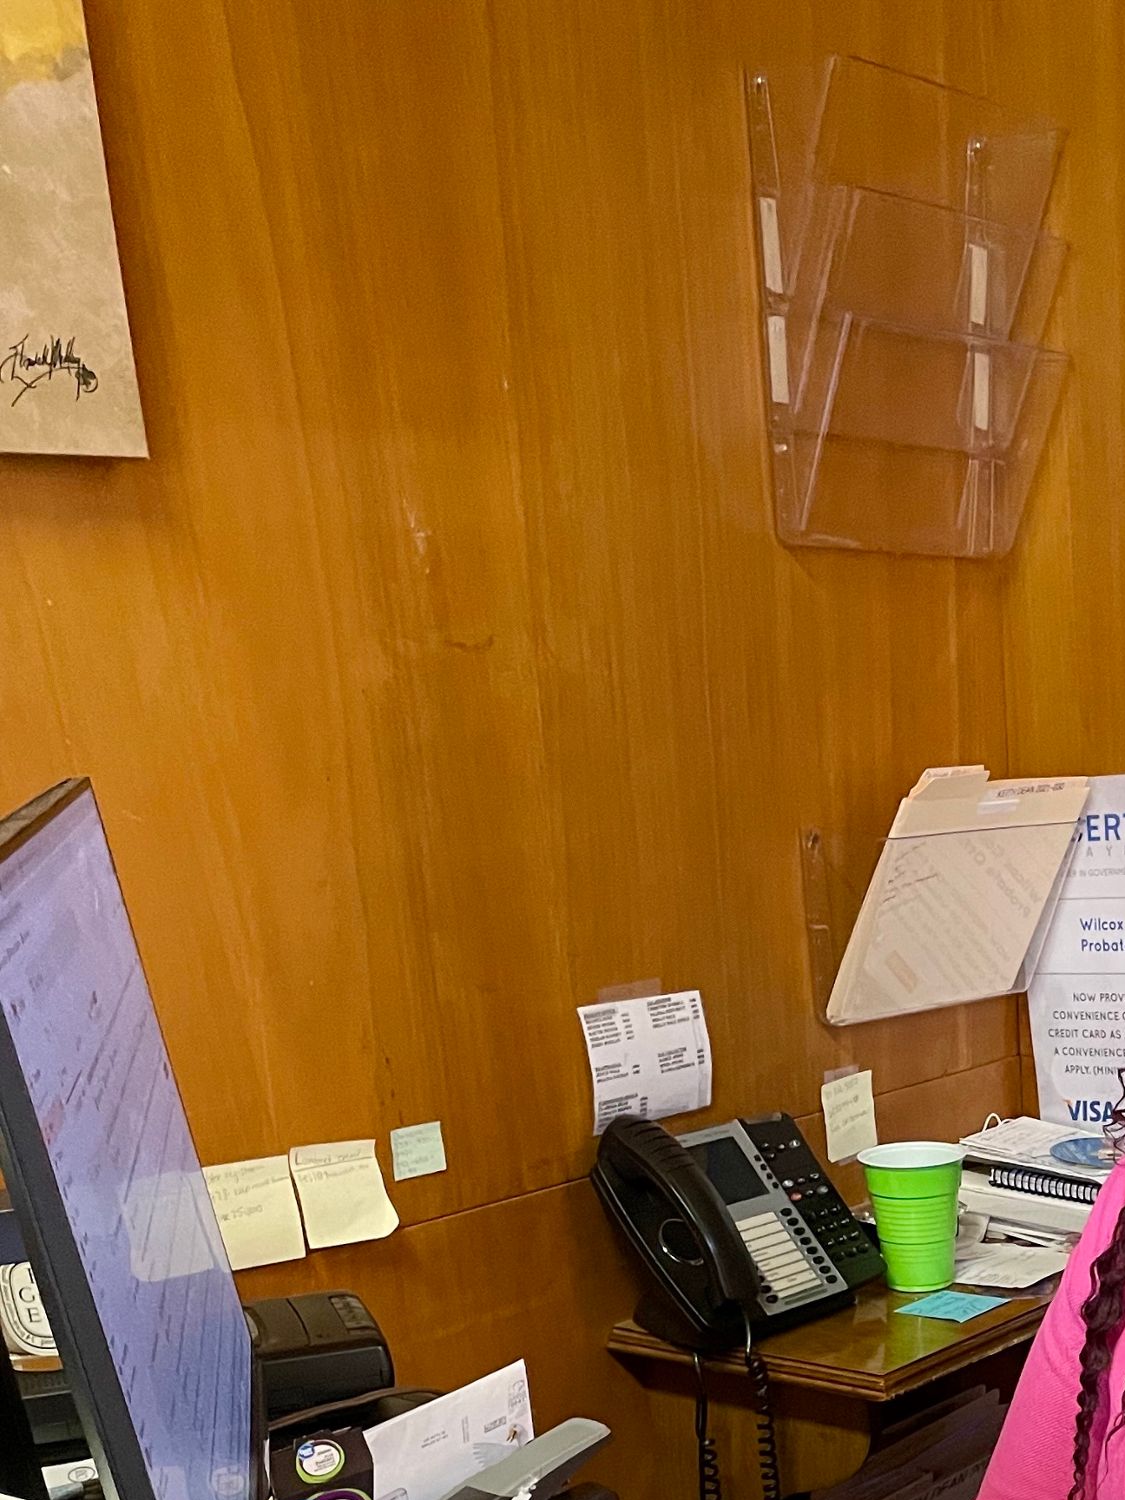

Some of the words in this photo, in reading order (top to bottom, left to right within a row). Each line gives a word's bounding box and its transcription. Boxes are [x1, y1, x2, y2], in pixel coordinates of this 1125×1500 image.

[1079, 918, 1124, 932] Wilcox
[1073, 993, 1096, 1002] NOW
[1053, 1010, 1119, 1021] CONVENIENCE
[1048, 1028, 1078, 1039] CREDIT
[1082, 1030, 1107, 1039] CARD
[1110, 1030, 1122, 1039] AS
[1066, 1100, 1114, 1123] VISA
